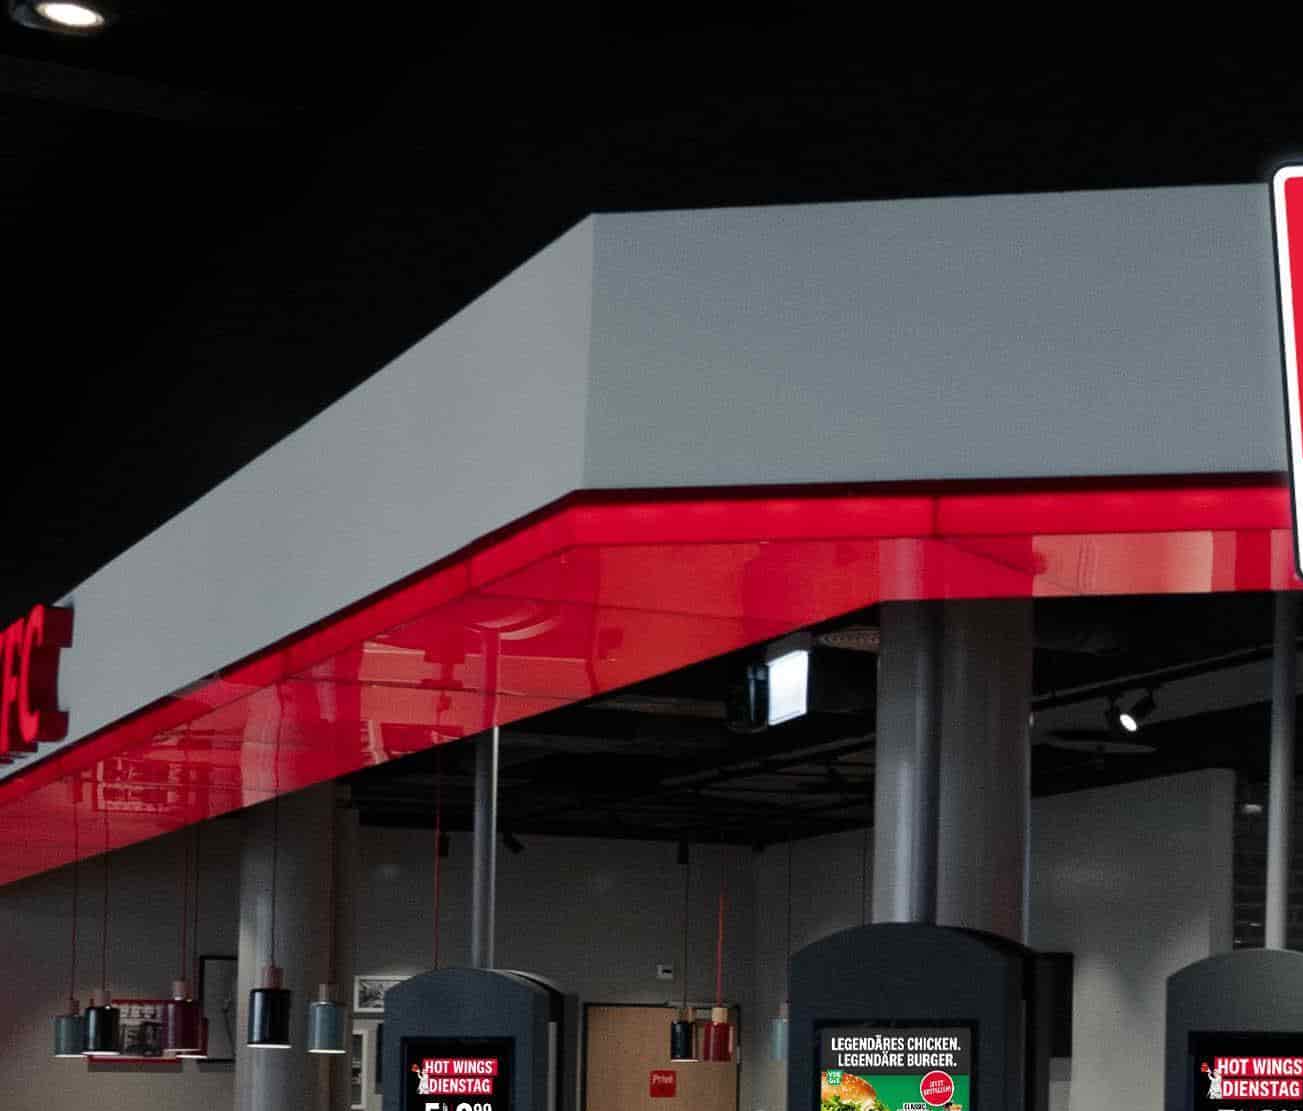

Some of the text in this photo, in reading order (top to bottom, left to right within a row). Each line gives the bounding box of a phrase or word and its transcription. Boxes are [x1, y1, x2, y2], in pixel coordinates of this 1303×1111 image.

[0, 604, 45, 754] FC
[831, 1034, 961, 1051] LEGENDÄRES CHICKEN.
[425, 1060, 449, 1074] HOT
[838, 1050, 957, 1067] LEGENDÄRE BURGER.
[1218, 1058, 1248, 1075] HOT
[429, 1078, 490, 1094] DIENSTAG
[1223, 1080, 1300, 1097] DIENSTAG
